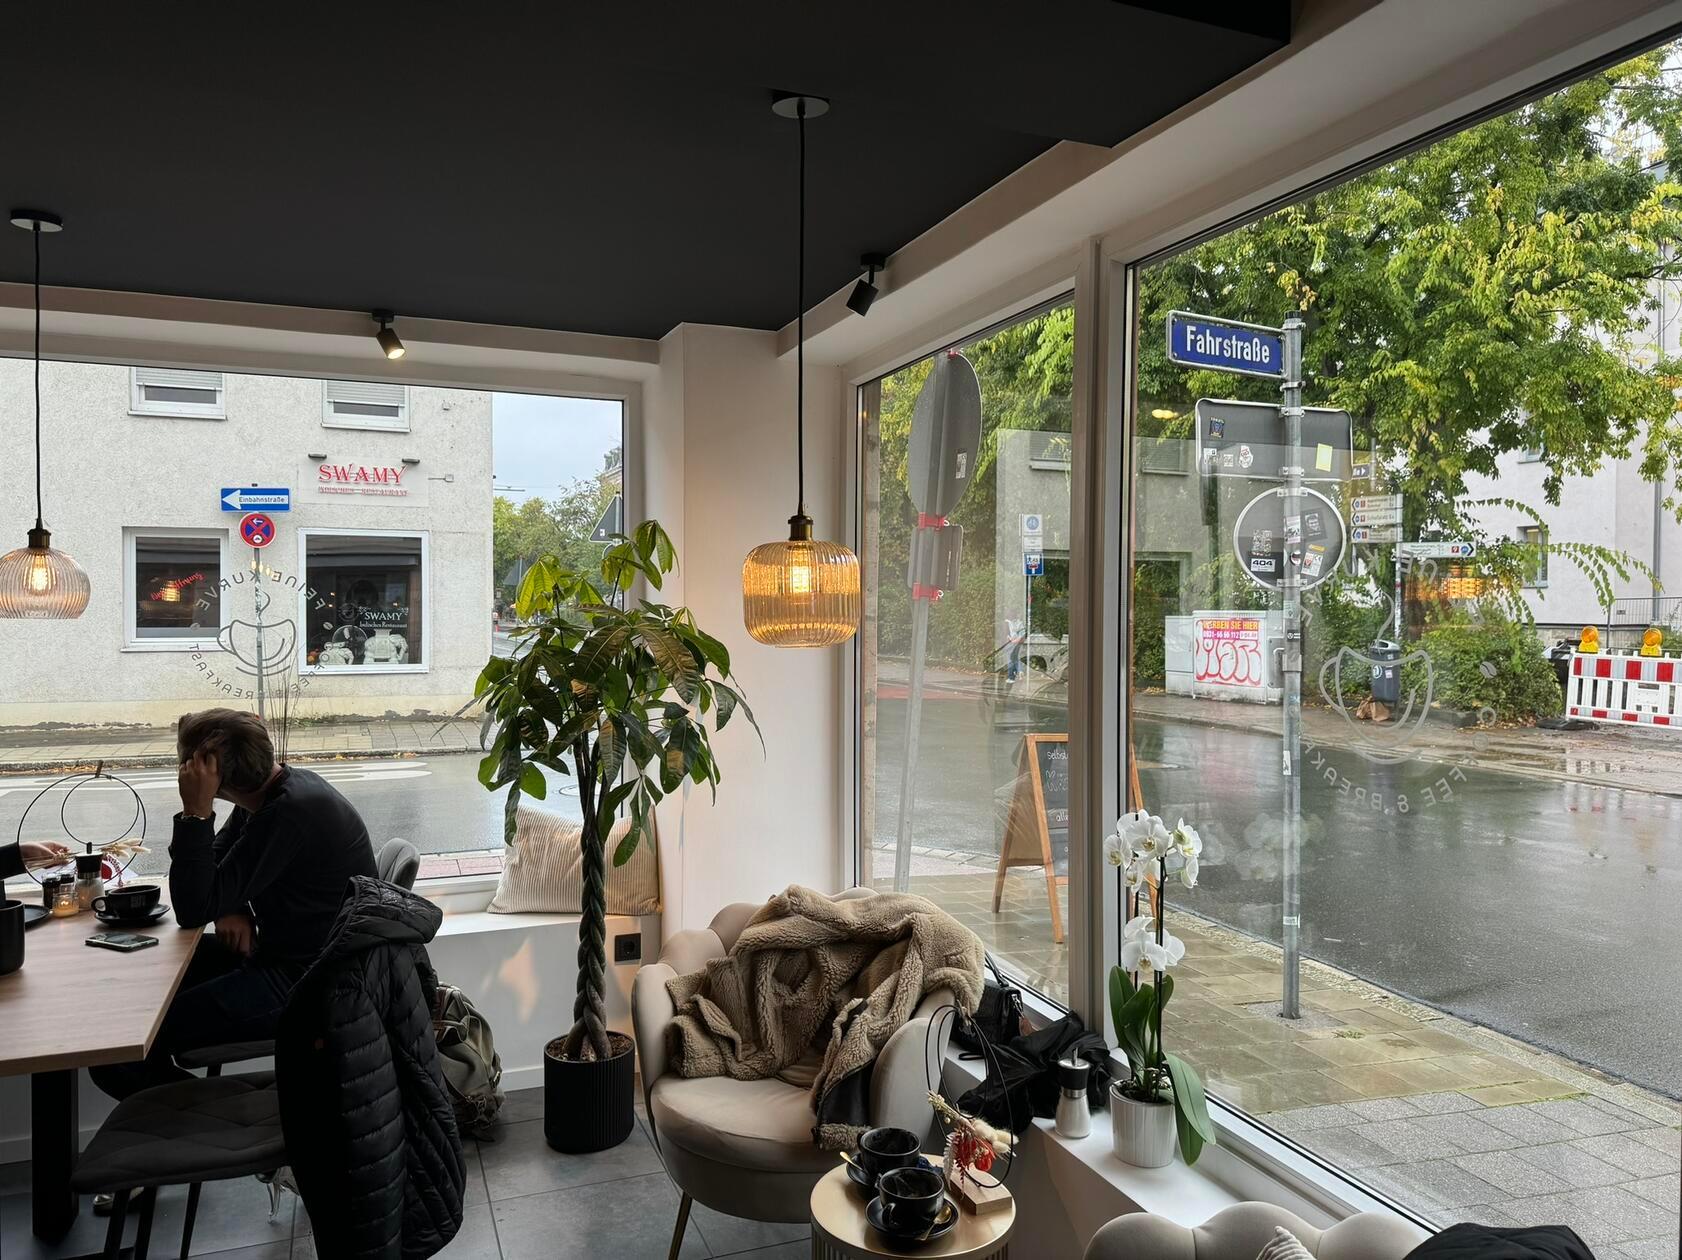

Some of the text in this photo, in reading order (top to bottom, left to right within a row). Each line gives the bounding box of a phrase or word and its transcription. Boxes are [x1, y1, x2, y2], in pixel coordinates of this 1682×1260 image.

[1186, 325, 1270, 364] Fahrstraße
[319, 463, 408, 485] SWAMY
[364, 612, 403, 621] SWAMY
